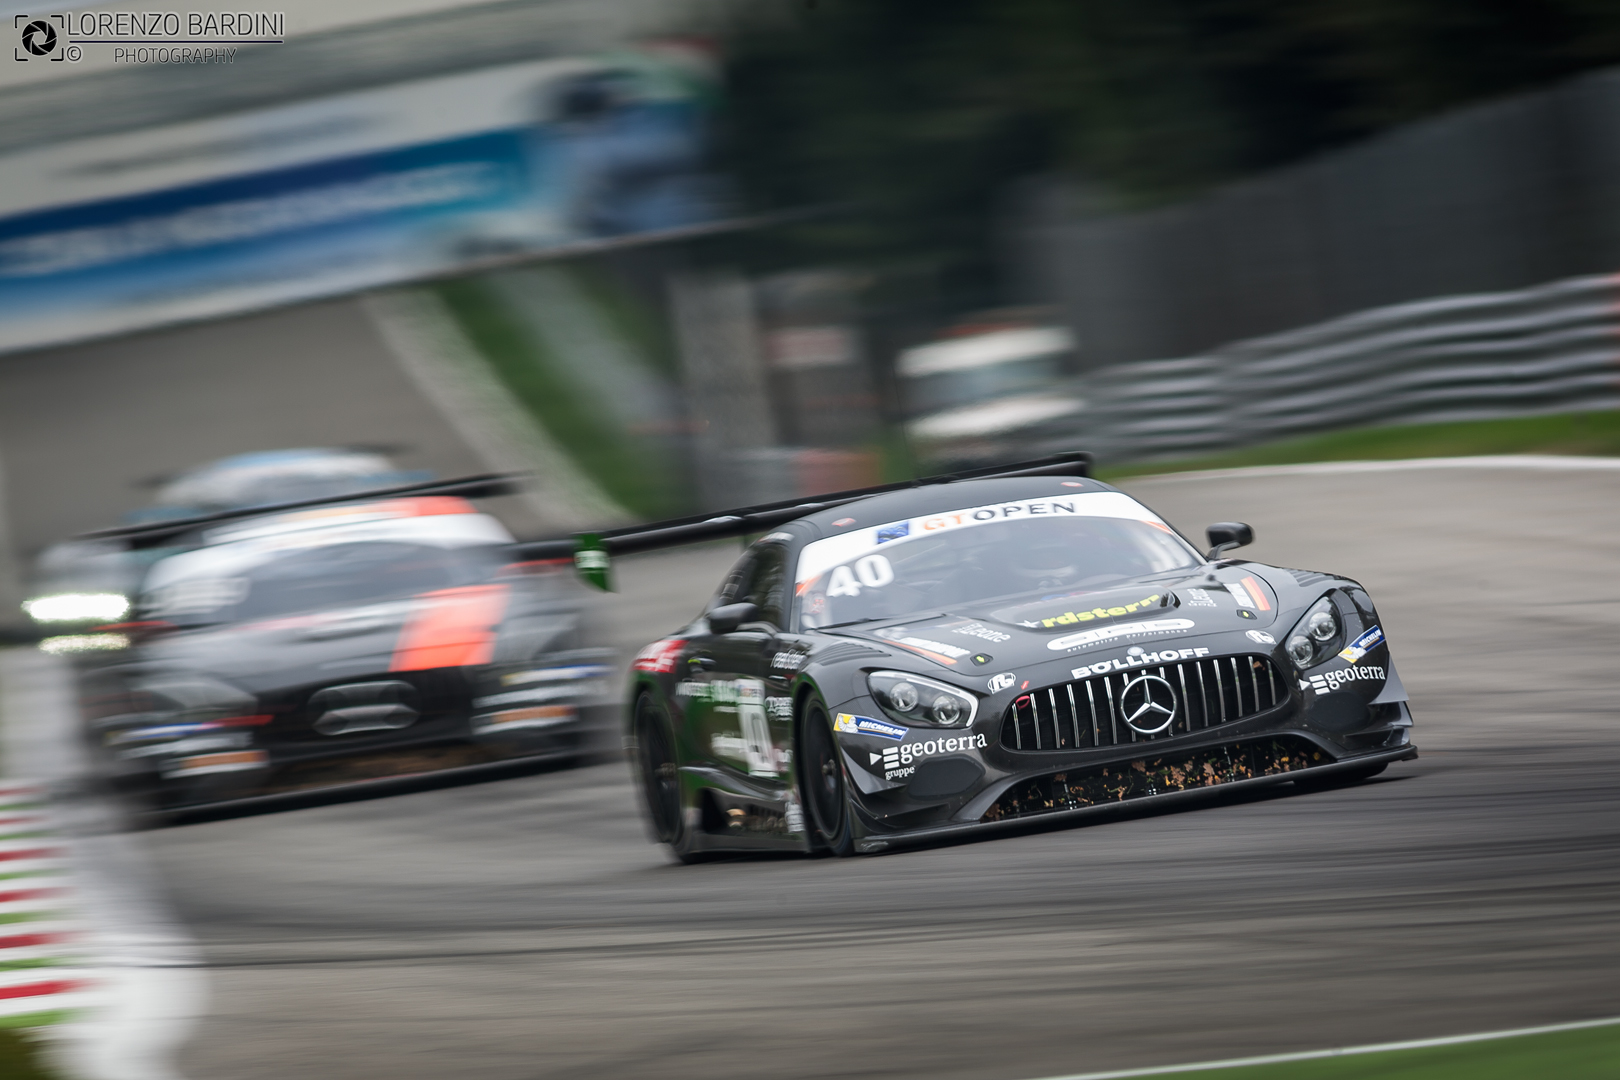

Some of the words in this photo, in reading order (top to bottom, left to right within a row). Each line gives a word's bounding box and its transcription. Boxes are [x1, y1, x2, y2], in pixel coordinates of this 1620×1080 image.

[826, 554, 895, 597] 40
[1324, 665, 1386, 690] geoterra
[858, 720, 906, 736] MICHELIN
[900, 732, 988, 764] geoterra
[885, 766, 915, 780] gruppe
